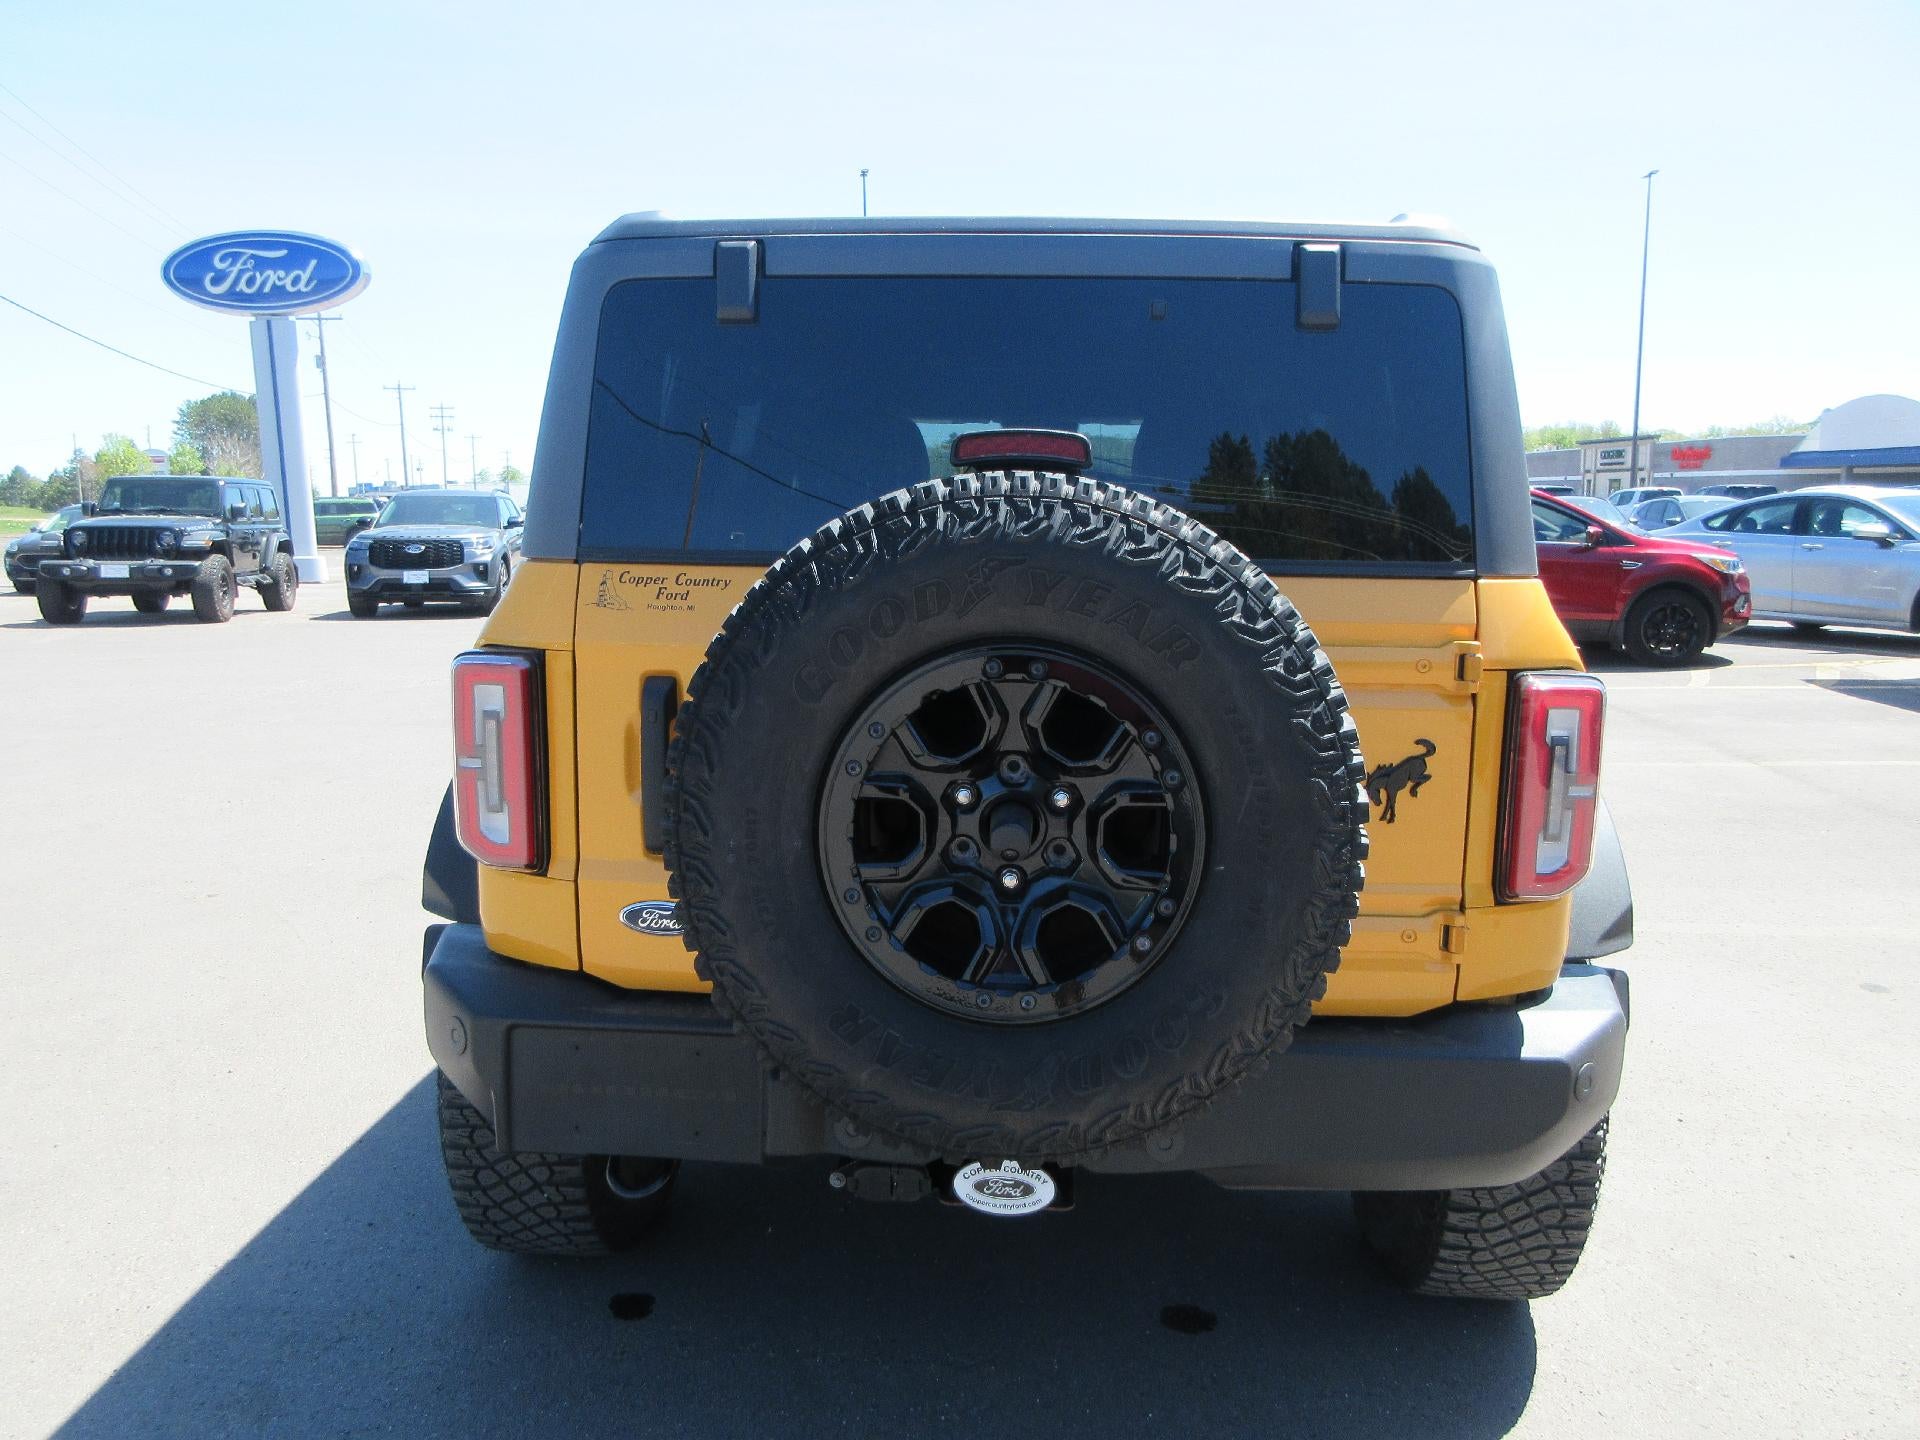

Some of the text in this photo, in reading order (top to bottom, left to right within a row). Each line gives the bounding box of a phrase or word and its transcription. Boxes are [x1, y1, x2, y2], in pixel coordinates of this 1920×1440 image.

[204, 248, 318, 295] Ford
[618, 570, 732, 591] Copper Country
[655, 586, 690, 602] Ford
[647, 603, 685, 612] Houghton,
[983, 1178, 1025, 1196] Ford
